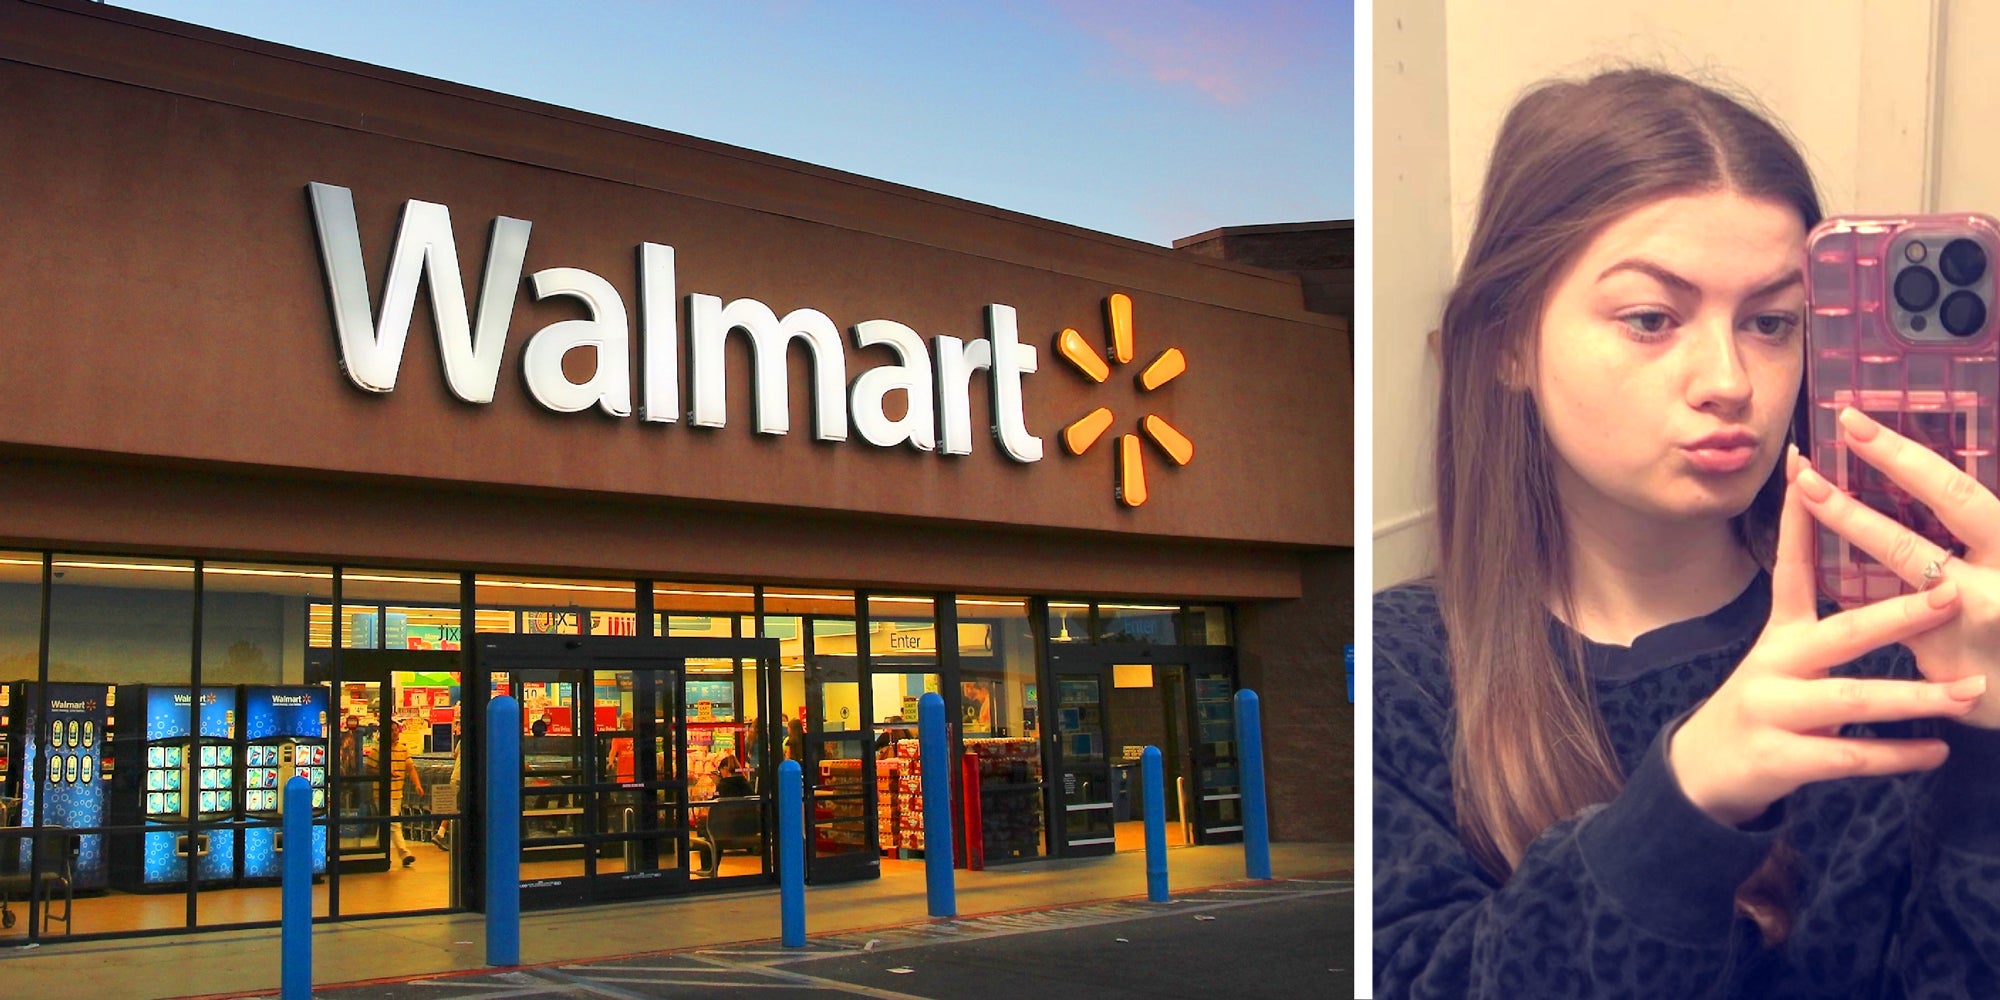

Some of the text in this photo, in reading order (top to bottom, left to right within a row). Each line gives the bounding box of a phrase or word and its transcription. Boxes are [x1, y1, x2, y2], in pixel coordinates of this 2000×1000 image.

[307, 181, 1044, 464] Walmart
[890, 632, 921, 649] Enter
[174, 695, 207, 703] Walrt
[272, 695, 302, 703] Walmart
[51, 700, 86, 709] Walmart
